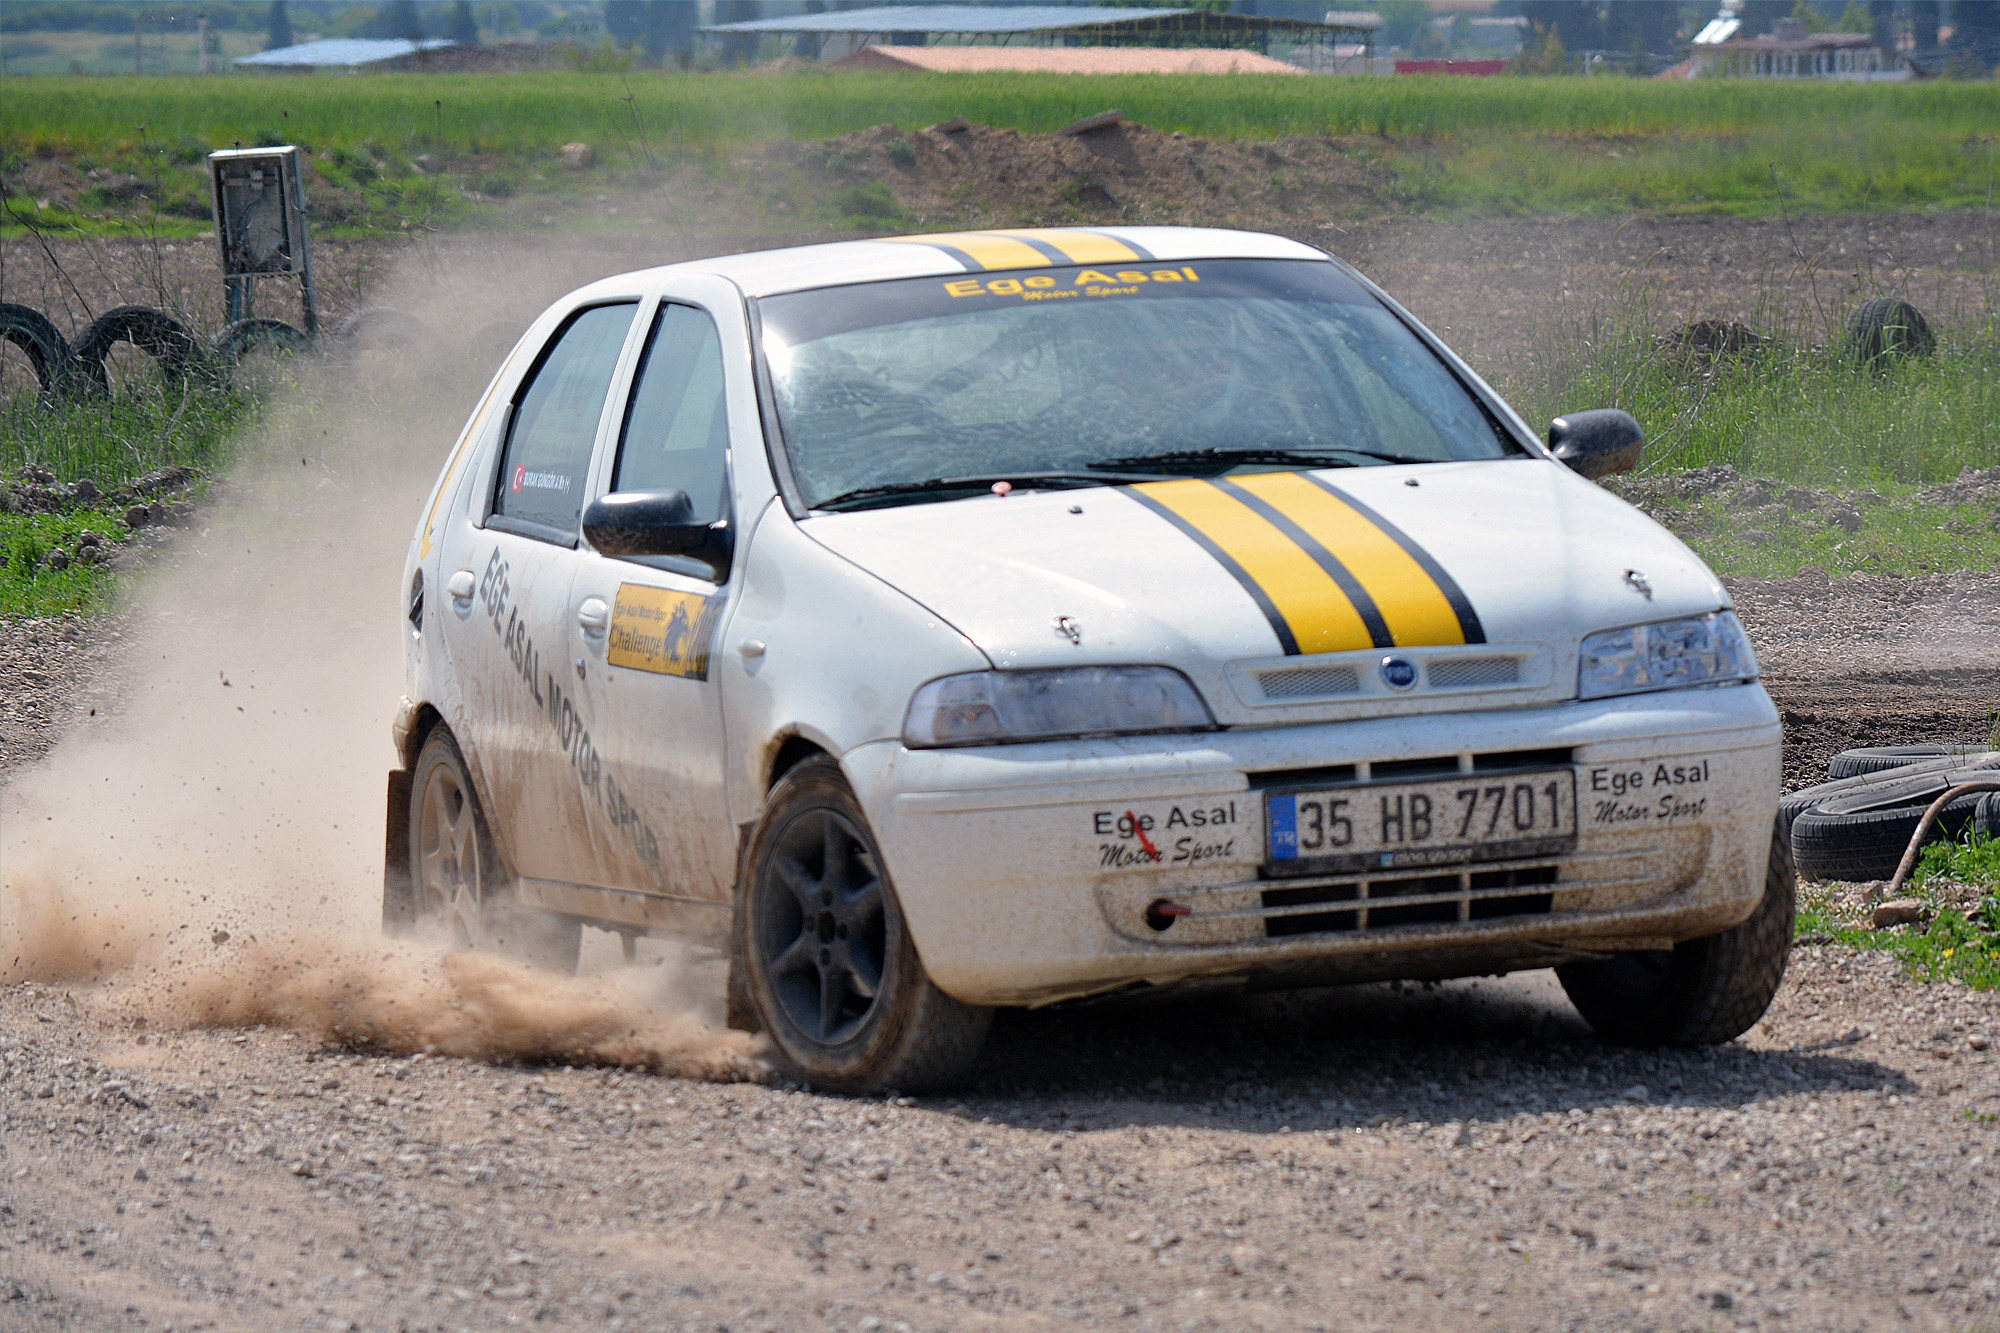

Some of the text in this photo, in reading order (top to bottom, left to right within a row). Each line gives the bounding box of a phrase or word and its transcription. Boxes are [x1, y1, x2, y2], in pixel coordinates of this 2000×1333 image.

[943, 266, 1201, 298] Ege Asal
[1022, 285, 1139, 301] Motor Sport
[611, 624, 662, 662] Challenge
[504, 604, 544, 708] ASAL
[548, 673, 602, 806] MOTOR
[1591, 759, 1709, 795] Ege Asal
[1093, 802, 1236, 840] Ege Asal
[1300, 781, 1559, 848] 35 HB 7701
[1594, 794, 1706, 824] Motor Sport
[1171, 838, 1234, 866] Sport
